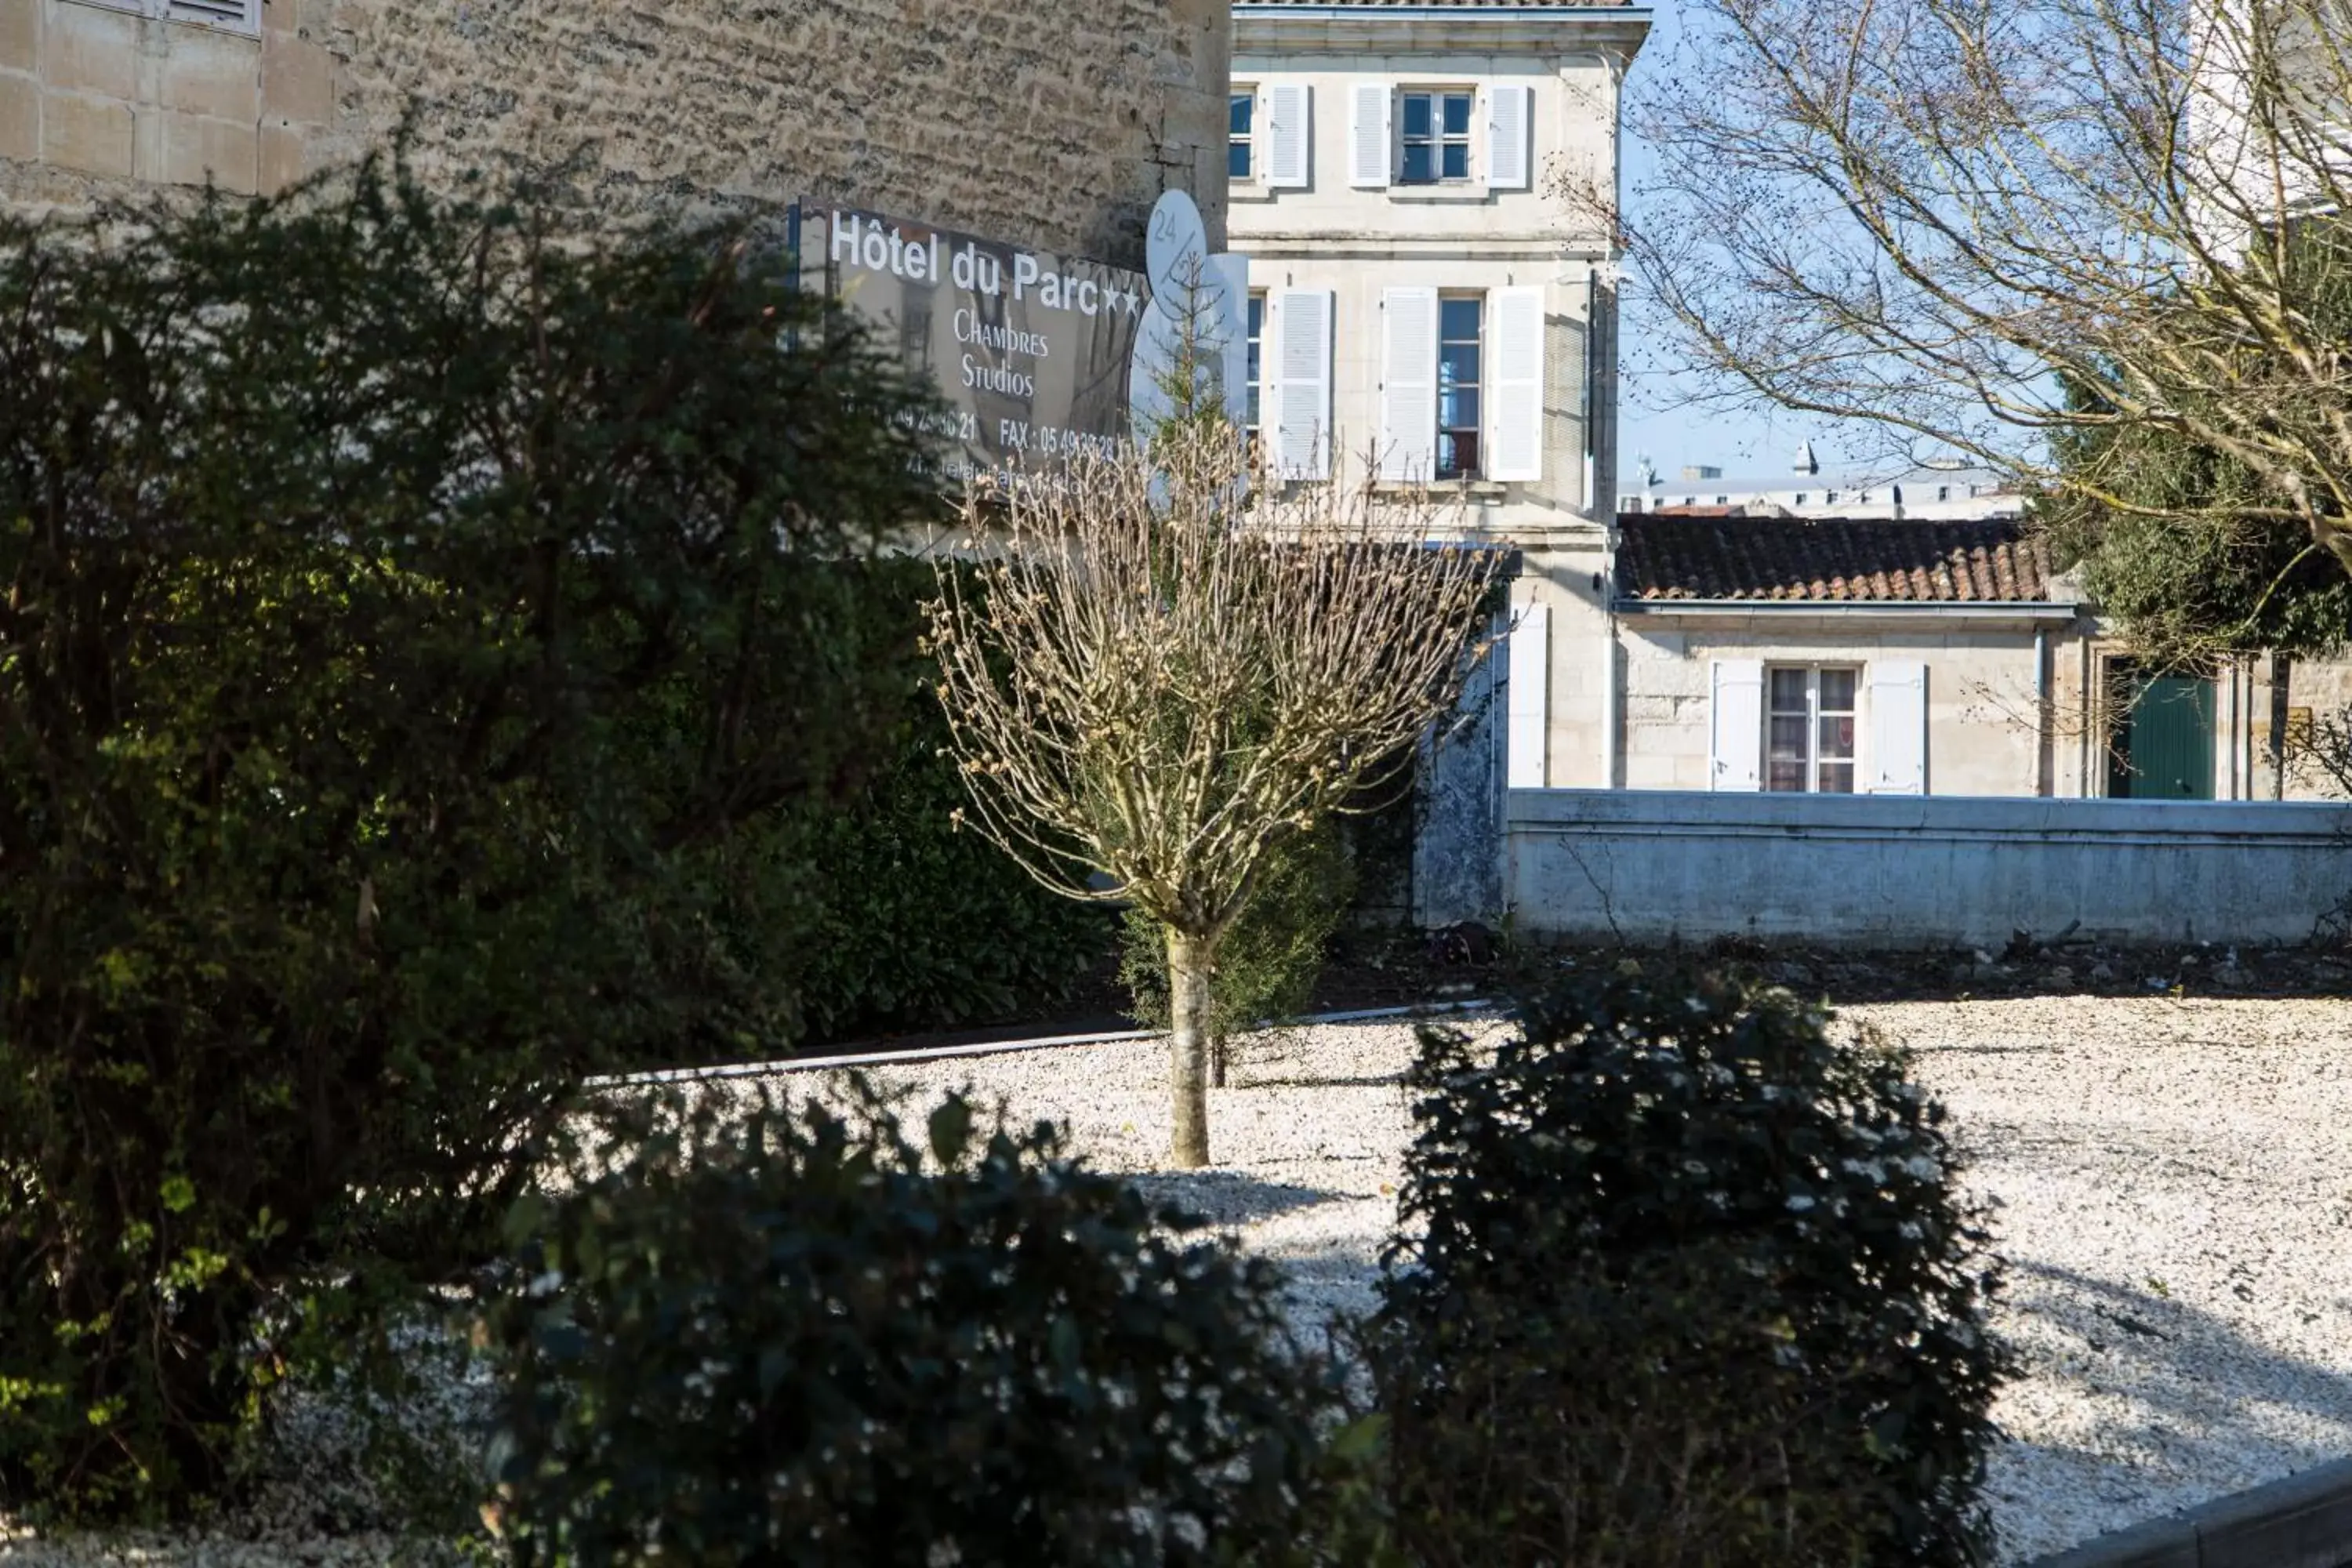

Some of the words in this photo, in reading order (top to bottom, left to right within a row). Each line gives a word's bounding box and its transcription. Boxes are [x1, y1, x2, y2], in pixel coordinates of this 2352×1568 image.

[833, 210, 938, 281] Hôtel
[953, 241, 1000, 296] du
[1014, 252, 1098, 315] Parc
[959, 412, 975, 440] 21
[1000, 418, 1028, 449] FAX
[1040, 426, 1058, 453] 05
